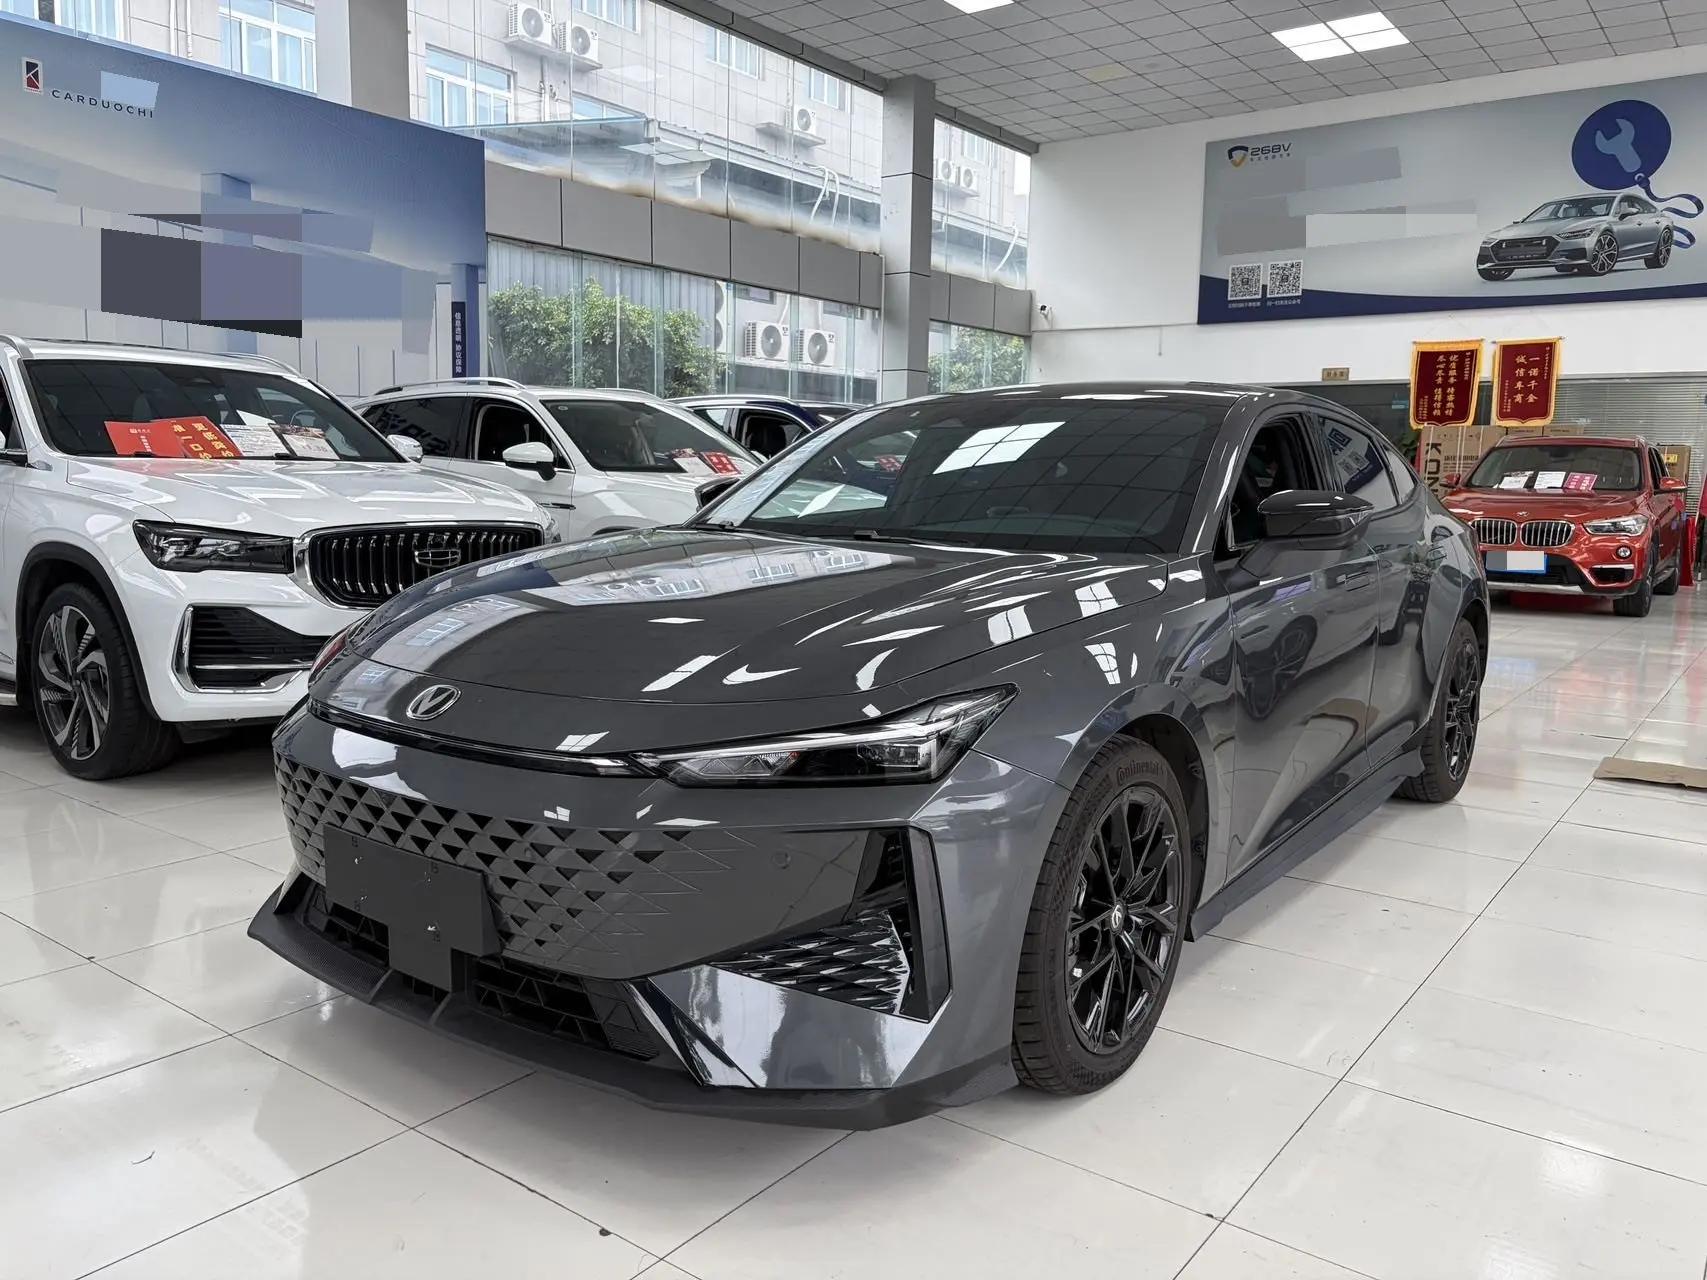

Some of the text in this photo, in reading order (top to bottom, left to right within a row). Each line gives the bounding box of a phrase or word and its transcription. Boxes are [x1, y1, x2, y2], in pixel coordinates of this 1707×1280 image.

[51, 89, 153, 118] CARDUOCHI
[1513, 354, 1528, 404] 诚信车商
[1525, 356, 1541, 403] 一诺千金
